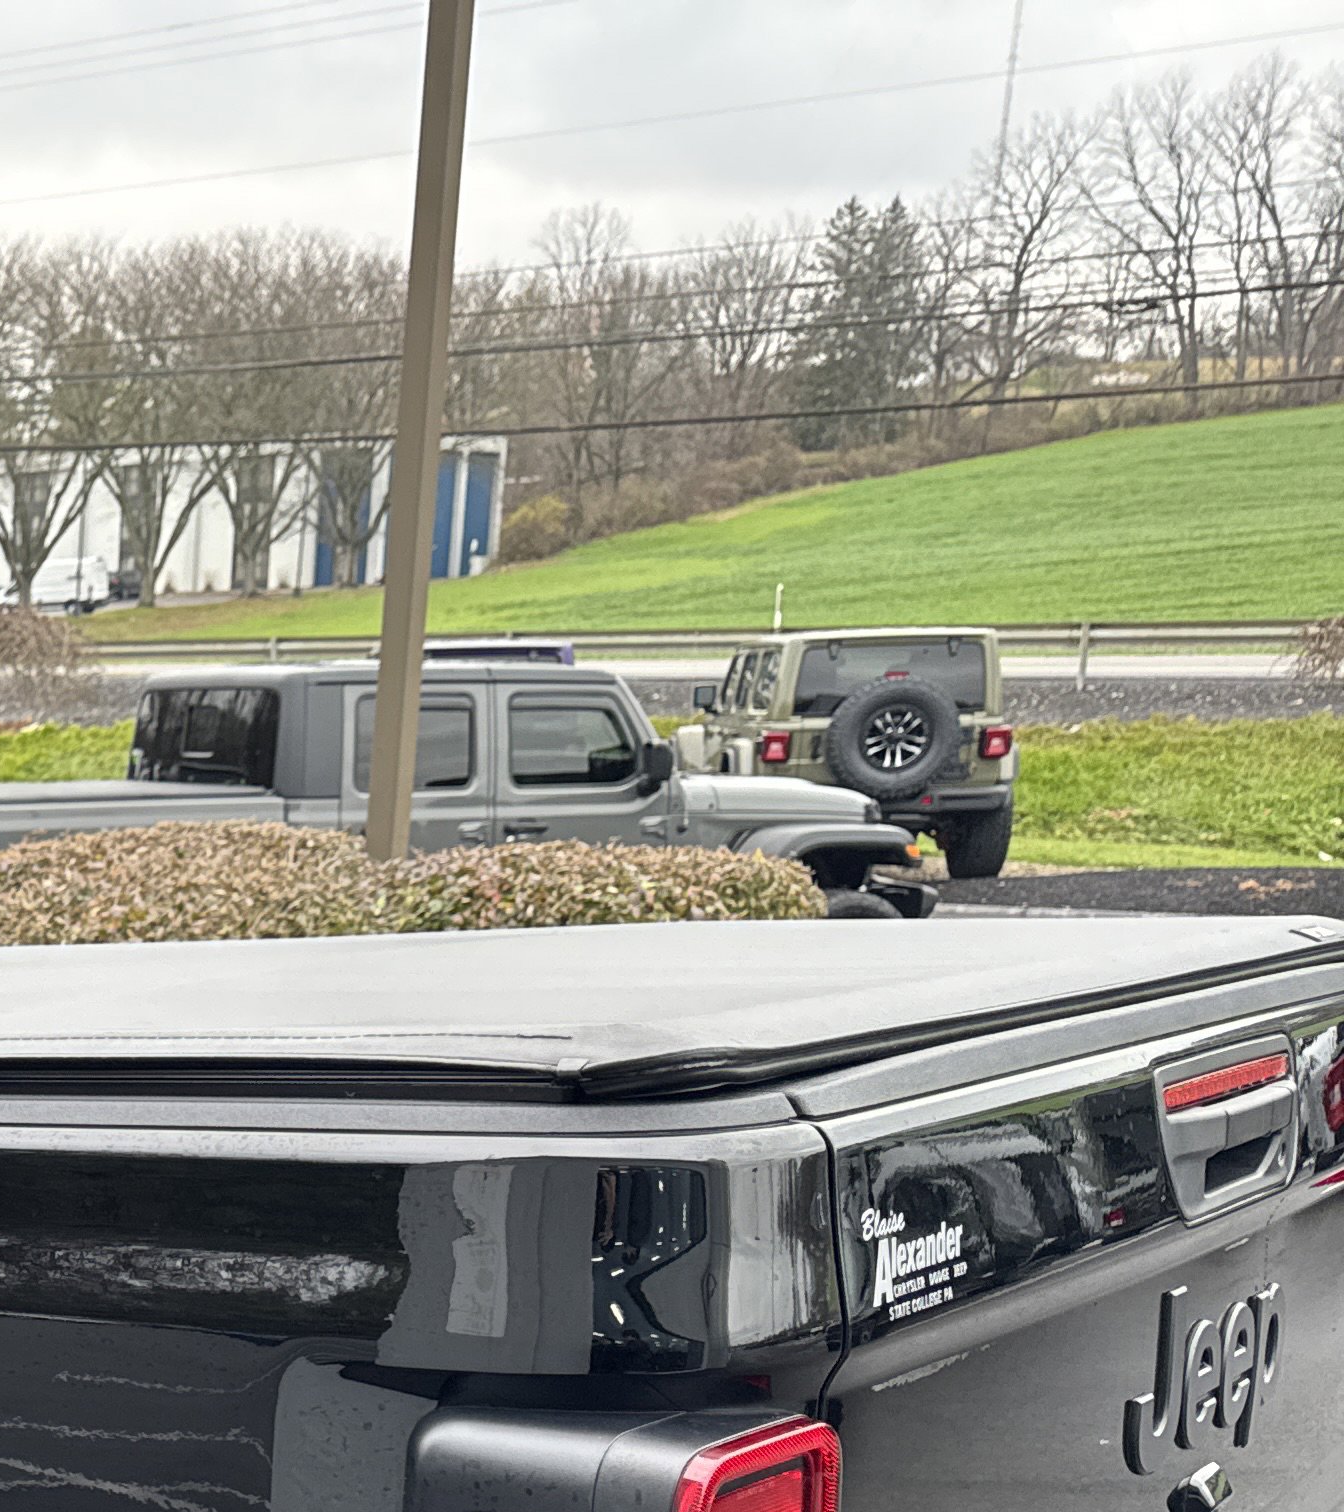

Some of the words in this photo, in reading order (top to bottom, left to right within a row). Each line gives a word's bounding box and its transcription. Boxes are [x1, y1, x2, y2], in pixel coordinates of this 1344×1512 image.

[861, 1207, 906, 1241] Blaise
[873, 1220, 963, 1308] Alexander
[889, 1301, 911, 1321] STATE
[912, 1290, 943, 1313] COLLEGE
[944, 1286, 954, 1302] PA
[894, 1276, 926, 1298] CHRYSLER
[1122, 1283, 1287, 1476] Jeep
